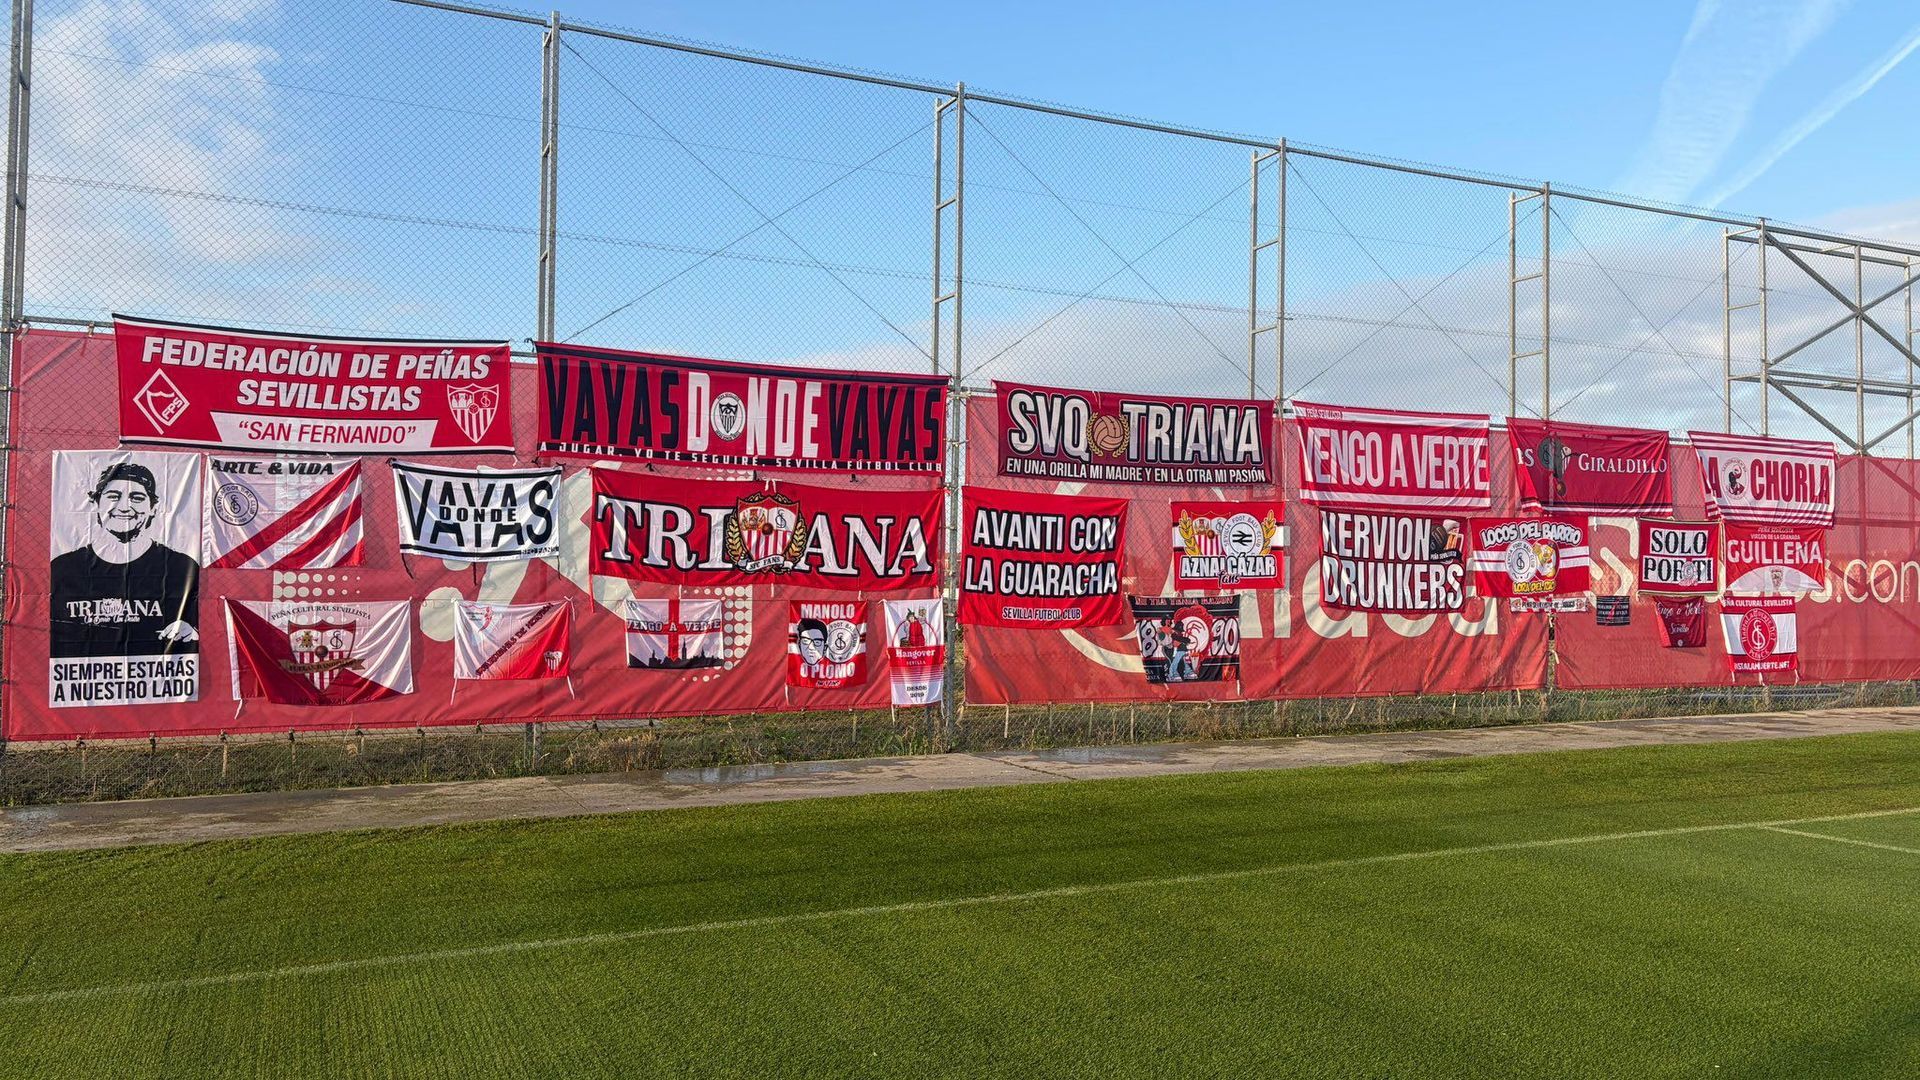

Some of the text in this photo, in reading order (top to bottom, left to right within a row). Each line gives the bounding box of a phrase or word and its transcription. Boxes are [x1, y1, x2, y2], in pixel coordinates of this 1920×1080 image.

[141, 336, 491, 380] FEDERACIÓN DE PEÑAS
[236, 378, 422, 411] SEVILLISTAS
[543, 356, 680, 450] VAYAS
[829, 383, 941, 461] VAYAS
[1008, 391, 1262, 464] SVQ TRIANA
[211, 459, 335, 476] ARTE & VIDA
[540, 441, 548, 451] A
[634, 448, 653, 459] YO
[665, 450, 681, 461] TE
[775, 458, 839, 470] SEVILLA
[847, 459, 900, 471] FÚTBOL
[909, 461, 942, 472] CLUB
[1298, 425, 1490, 491] VENGO A VERTE
[1007, 457, 1266, 483] EN UNA ORILLA MI MADRE Y EN LA OTRA MI PASIÓN
[1750, 458, 1831, 505] CHORLA
[439, 505, 517, 523] DONDE
[595, 492, 935, 578] TRIANA
[972, 508, 1118, 552] AVANTI CON
[1320, 511, 1432, 561] NERVION
[1480, 521, 1582, 549] LOCOS DEL BARRIO
[1651, 530, 1708, 555] SOLO
[763, 555, 781, 567] FANS
[1180, 552, 1276, 578] AZNALCÁZAR
[1727, 539, 1823, 565] GUILLENA
[964, 556, 1118, 597] LA GUARACHA
[1322, 555, 1464, 610] DRUNKERS
[1644, 557, 1713, 582] POR TI
[270, 605, 372, 621] PEÑA CULTURAL SEVILLISTA
[800, 603, 856, 620] MANOLO
[1002, 606, 1033, 619] SEVILLA
[1062, 607, 1082, 620] CLUB
[1735, 599, 1763, 607] CULTURAL
[1763, 599, 1793, 607] SEVILLISTA
[627, 619, 722, 632] VENGO A VERTE
[1210, 617, 1240, 657] 90
[895, 649, 936, 660] Hangover
[53, 657, 195, 681] SIEMPRE ESTARÁS
[800, 662, 856, 679] O PLOMO
[54, 679, 195, 702] A NUESTRO LADO
